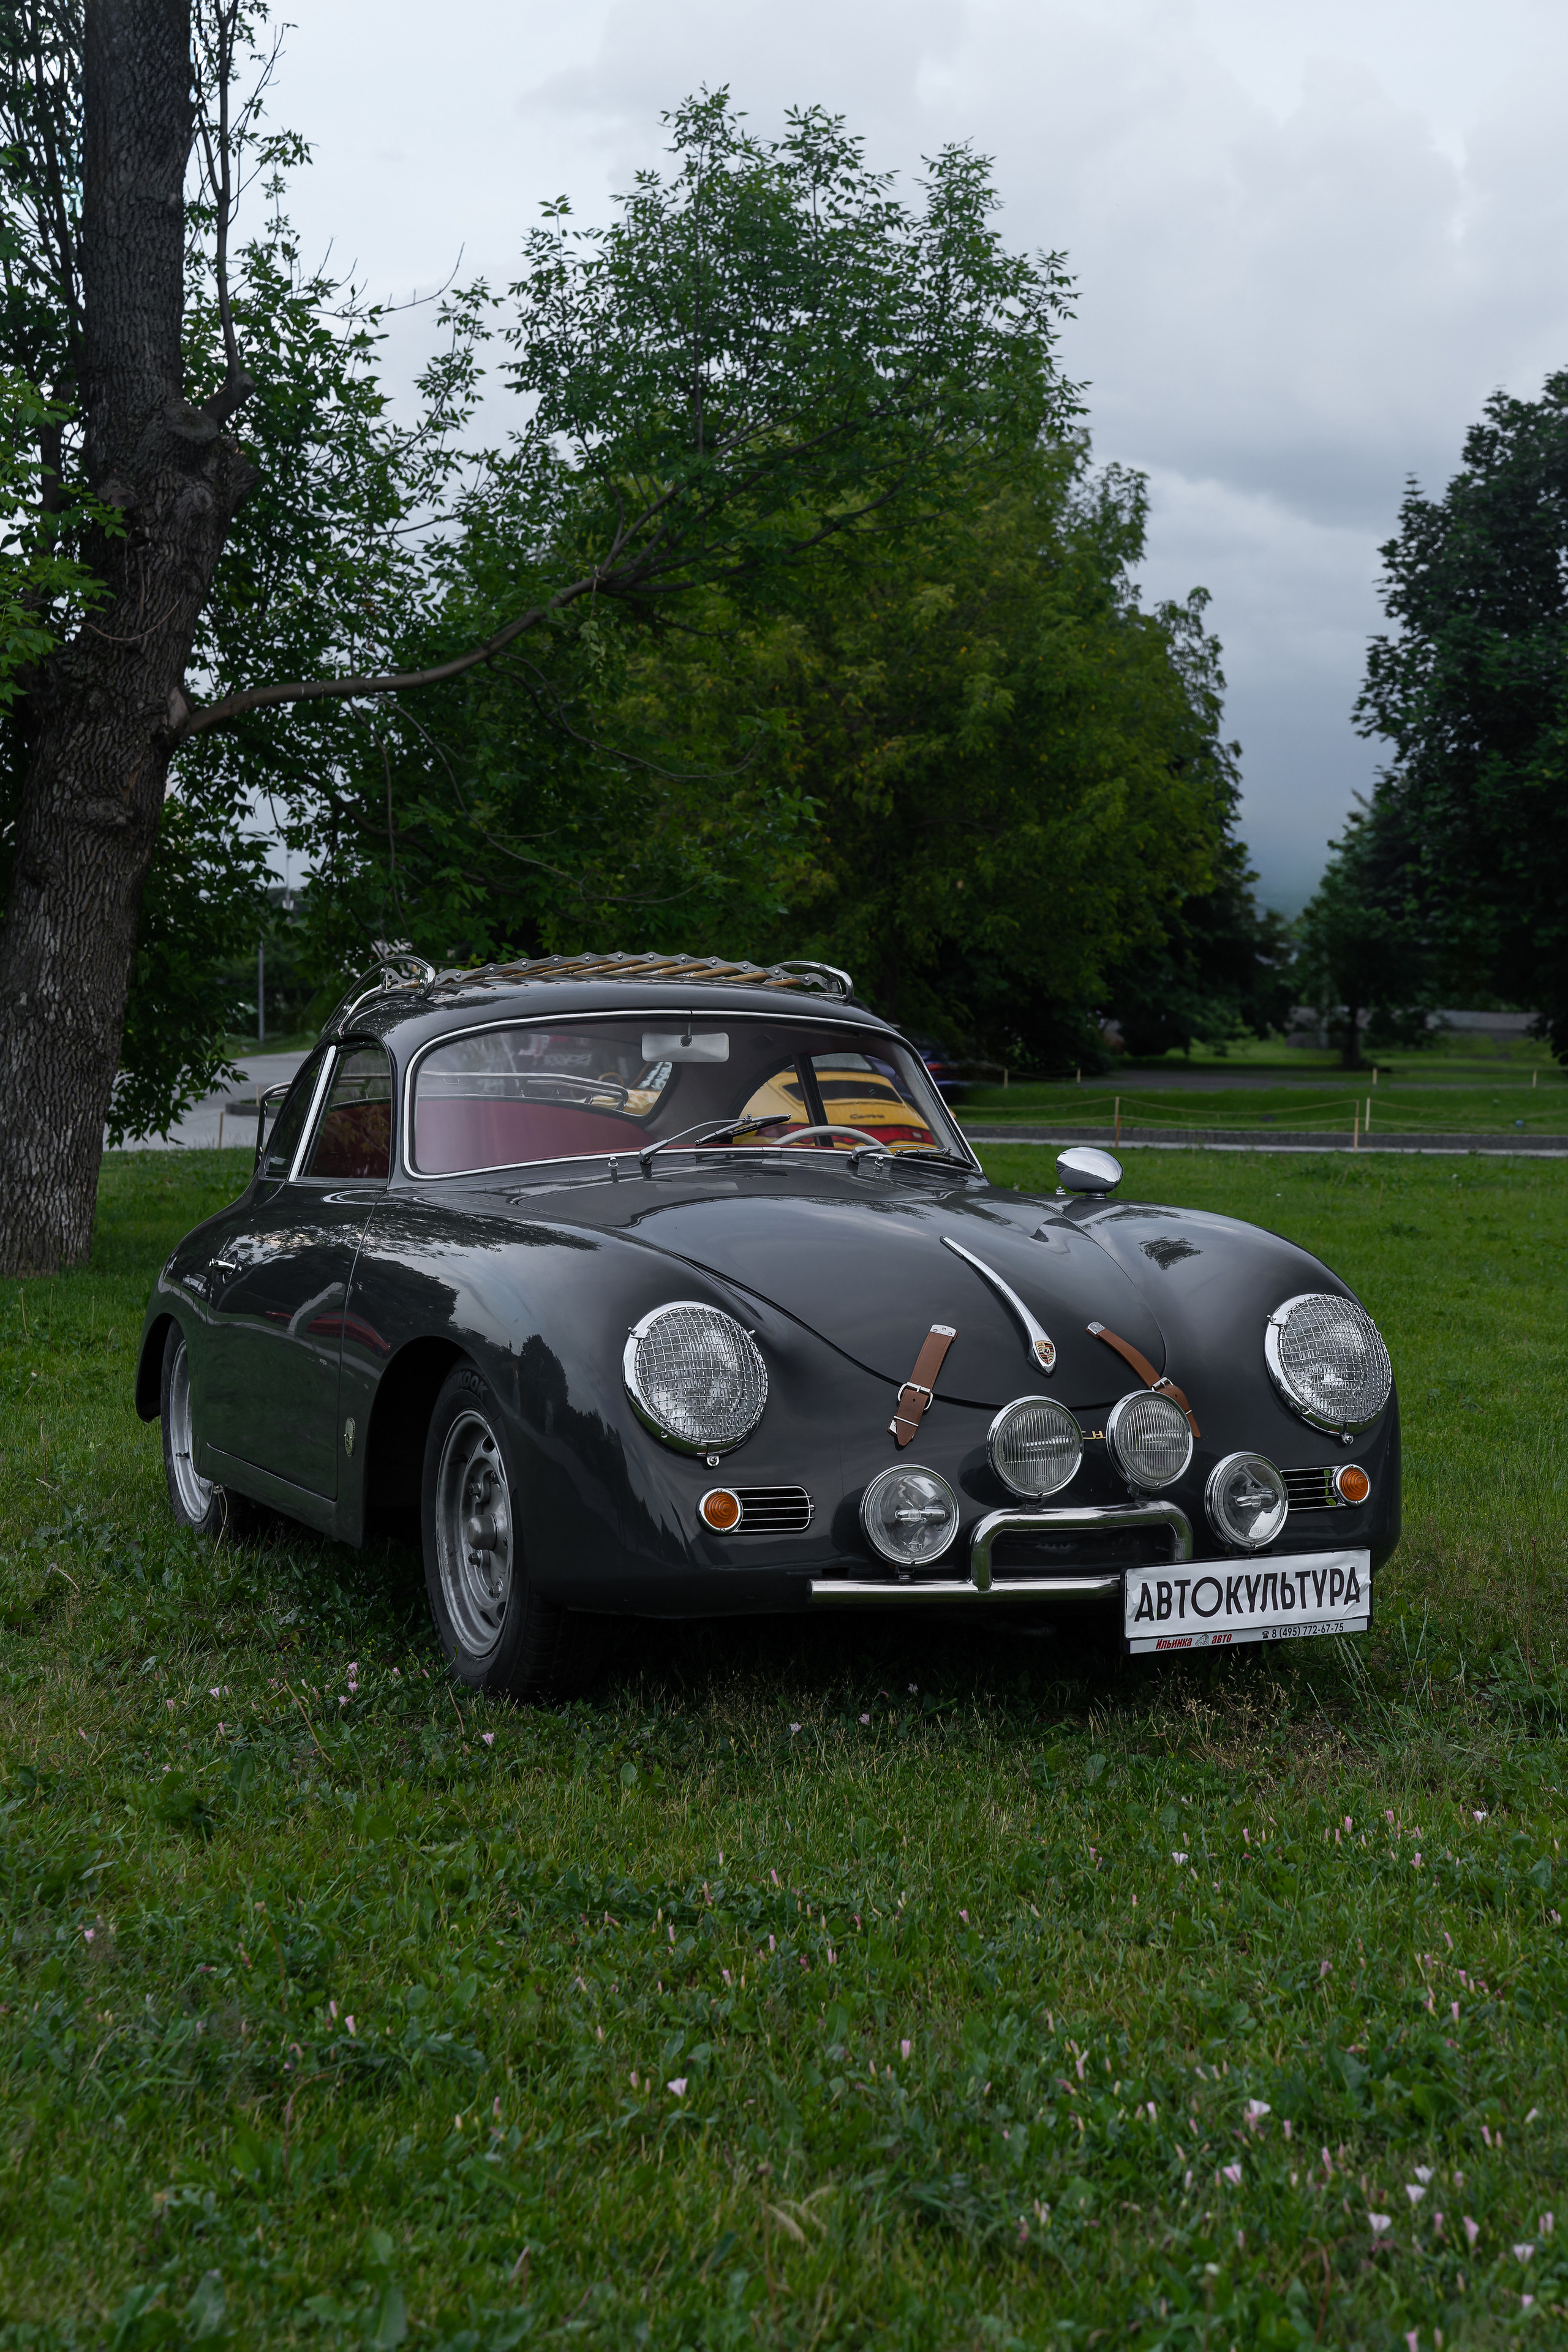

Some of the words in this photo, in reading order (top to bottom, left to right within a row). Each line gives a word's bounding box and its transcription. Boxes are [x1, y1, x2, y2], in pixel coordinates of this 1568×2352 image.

[1134, 1567, 1360, 1622] АВТОКУЛЬТУРА
[1272, 1629, 1277, 1638] 8
[1280, 1626, 1300, 1638] (495)
[1303, 1623, 1344, 1635] 772-67-75
[1155, 1637, 1193, 1650] Ильинка
[1211, 1634, 1232, 1644] авто
